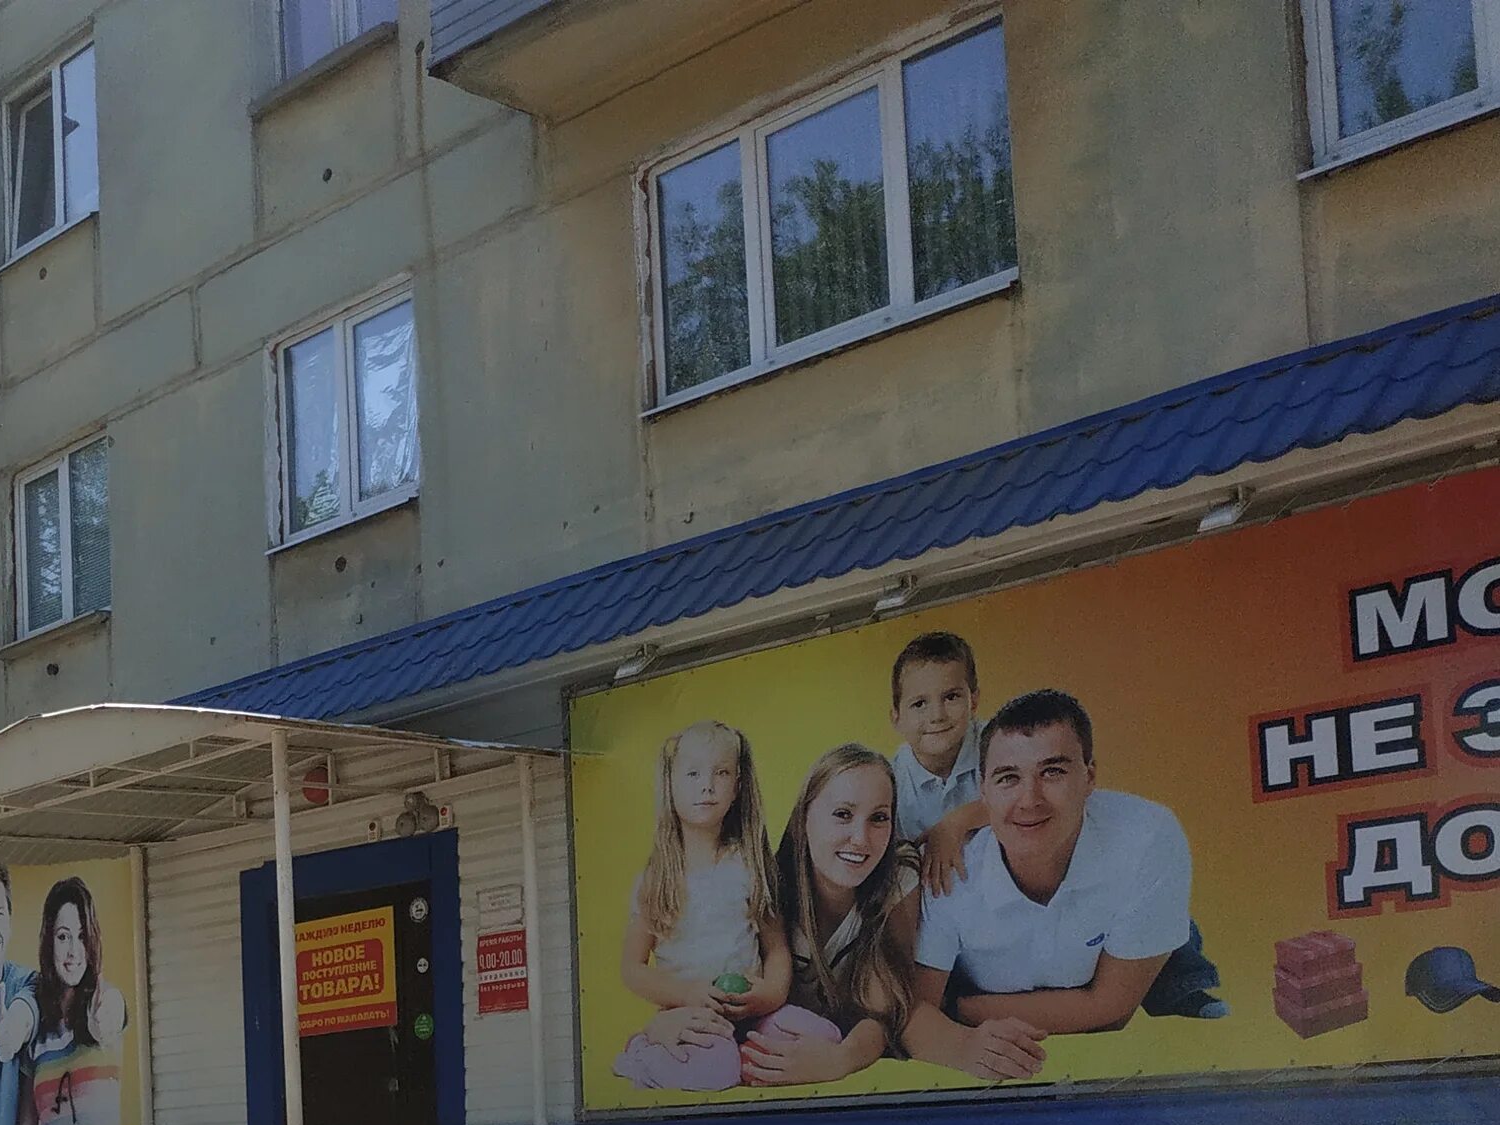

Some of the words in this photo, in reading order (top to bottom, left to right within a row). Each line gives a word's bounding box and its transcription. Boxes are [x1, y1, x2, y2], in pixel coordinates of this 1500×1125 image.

[1261, 698, 1423, 789] НЕ
[1339, 804, 1500, 907] ДО
[340, 918, 385, 934] НЕДЕЛЮ
[312, 944, 365, 968] НОВОЕ
[302, 960, 377, 981] ПОСТУПЛЕНИЕ
[299, 973, 380, 1000] ТОВАРА!
